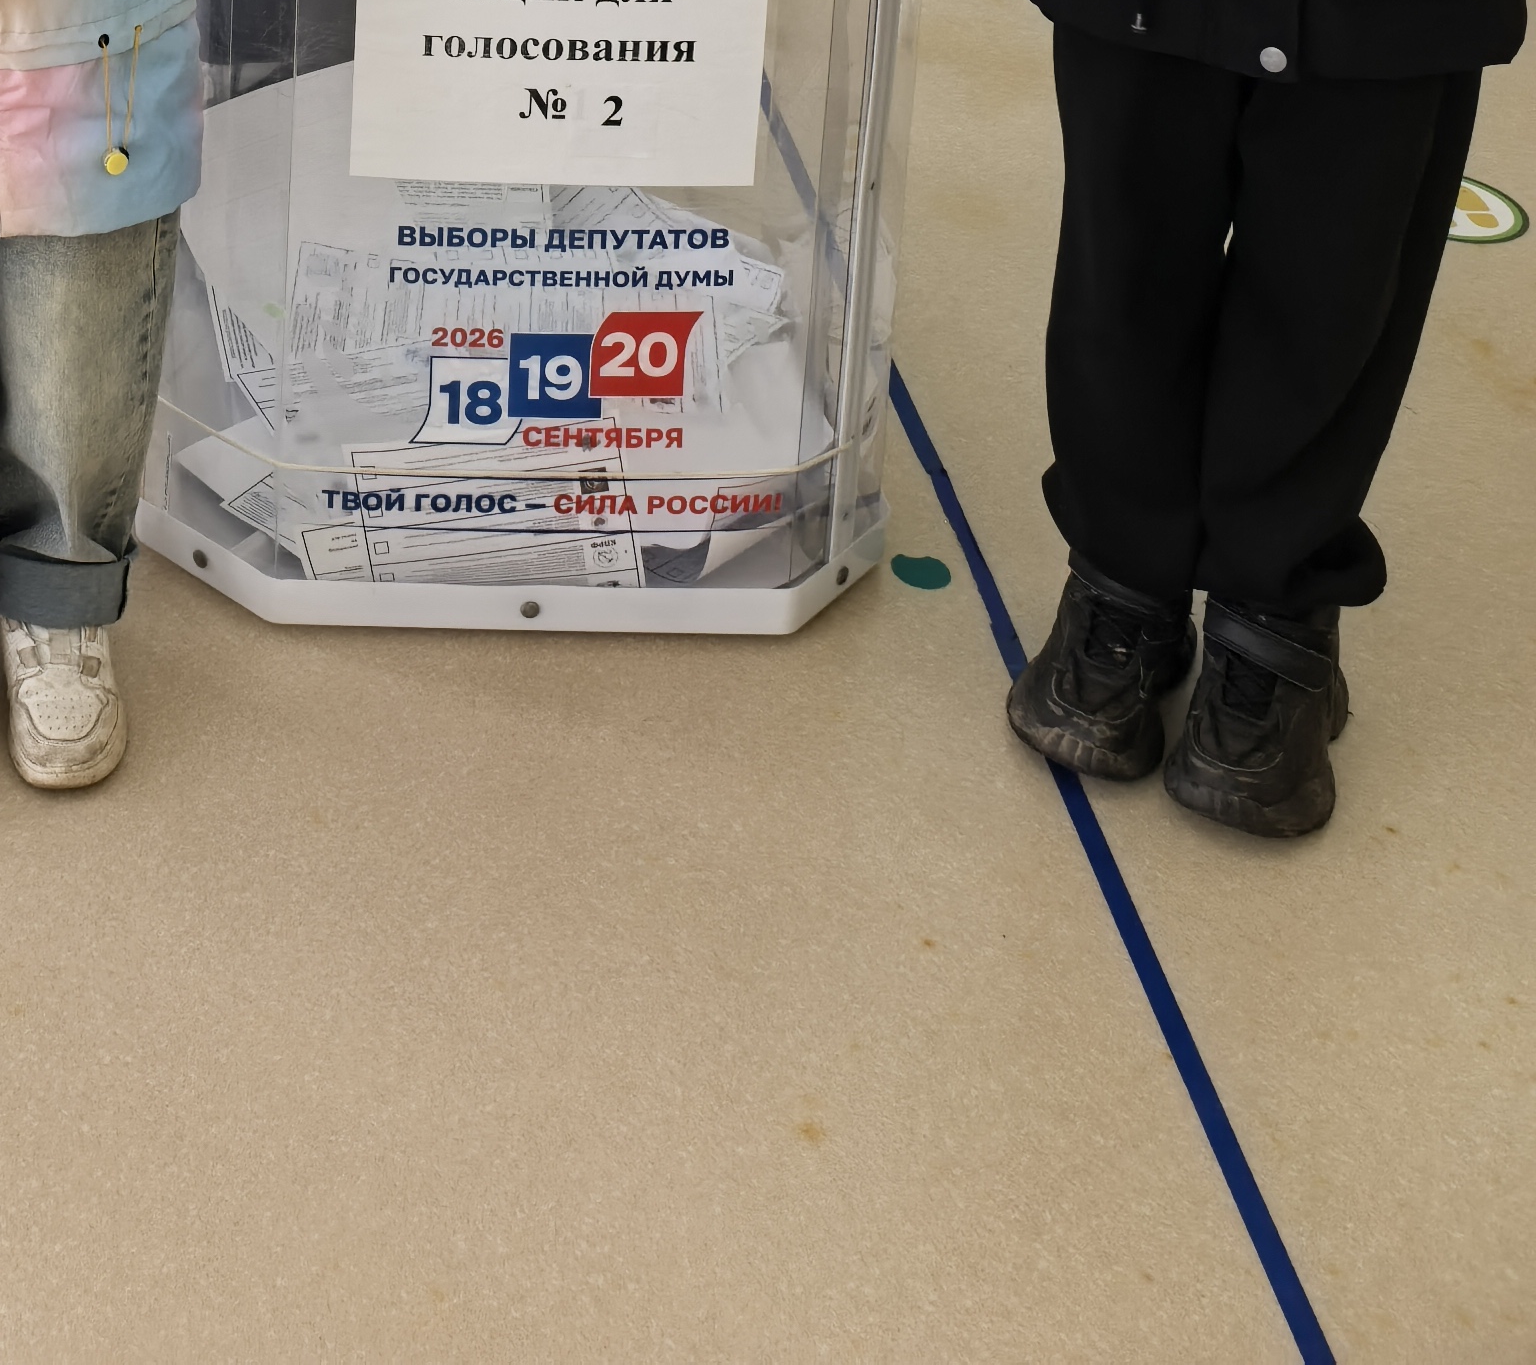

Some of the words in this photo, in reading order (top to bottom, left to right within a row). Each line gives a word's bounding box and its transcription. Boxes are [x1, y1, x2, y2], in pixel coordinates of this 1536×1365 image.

[421, 31, 697, 64] голосования
[518, 87, 568, 121] №
[600, 95, 624, 127] 2
[397, 225, 536, 250] ВЫБОРЫ
[544, 227, 730, 253] ДЕПУТАТОВ
[389, 265, 649, 289] ГОСУДАРСТВЕННОЙ
[655, 269, 735, 290] ДУМЫ
[431, 327, 504, 349] 2026
[438, 380, 503, 427] 18
[518, 355, 584, 402] 19
[599, 331, 679, 378] 20
[522, 424, 684, 450] СЕНТЯБРЯ
[321, 487, 410, 512] ТВОЙ
[414, 492, 517, 514] ГОЛОС
[553, 494, 638, 516] СИЛА
[647, 492, 783, 516] РОССИИ!
